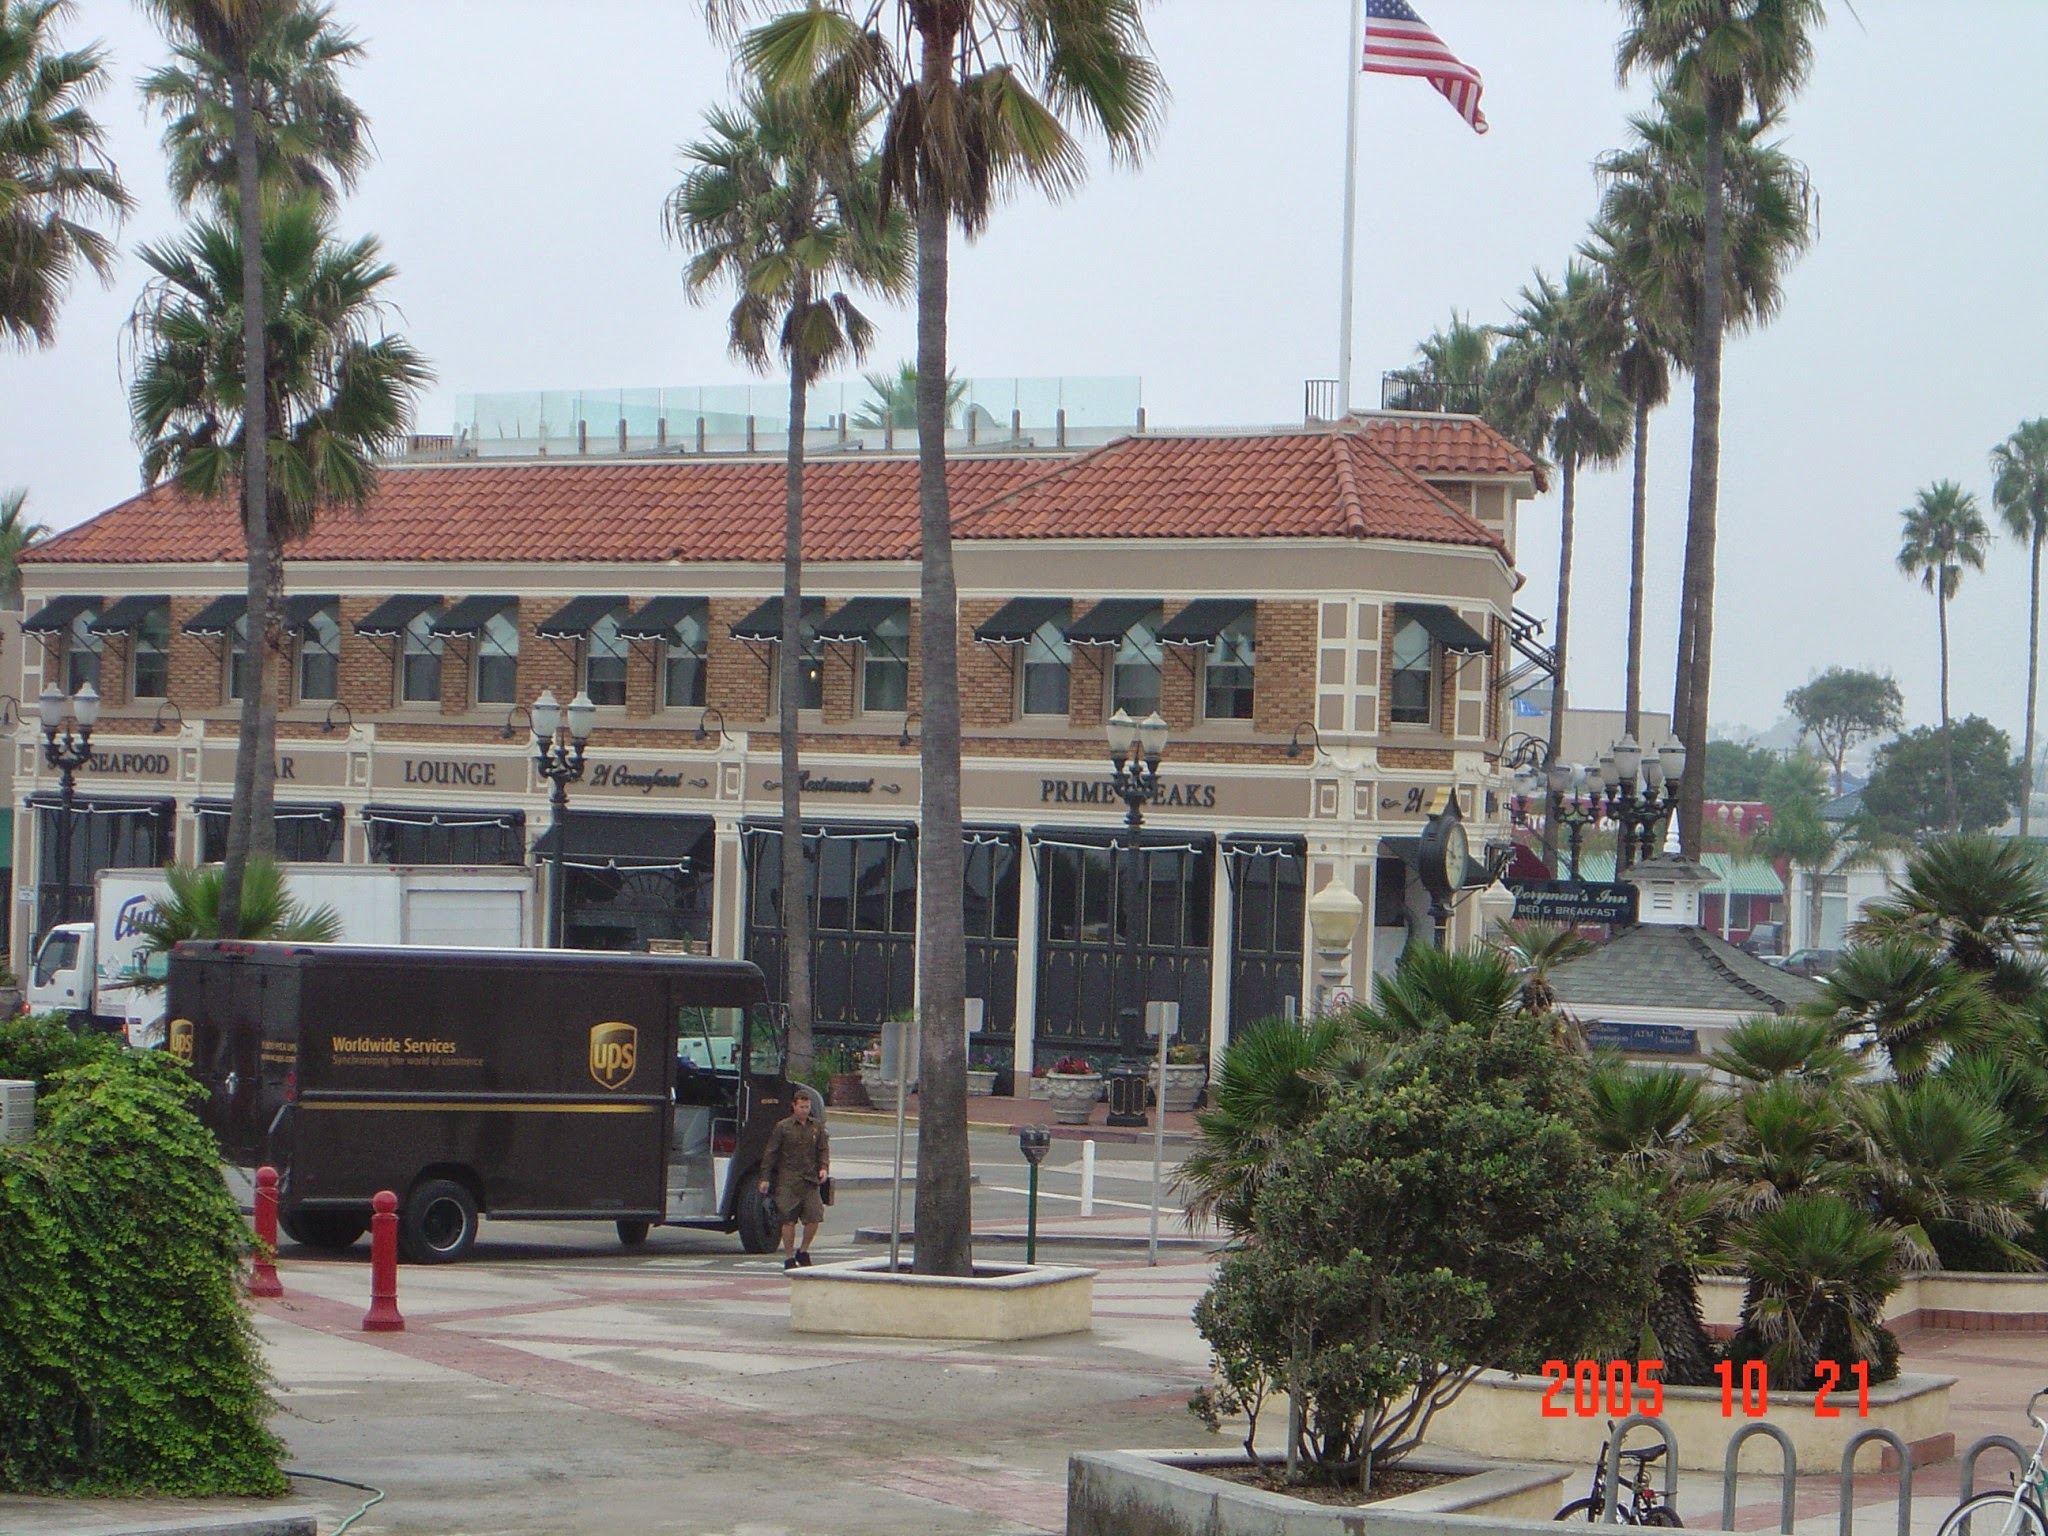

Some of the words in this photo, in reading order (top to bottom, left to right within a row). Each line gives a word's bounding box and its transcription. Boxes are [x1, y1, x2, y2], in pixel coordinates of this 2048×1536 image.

[88, 752, 170, 775] SEAFOOD
[403, 760, 496, 785] LOUNGE
[1040, 779, 1116, 804] PRIME
[1509, 884, 1589, 905] Doryman's
[1596, 889, 1628, 904] Inn
[1518, 904, 1539, 914] BED
[1543, 905, 1551, 914] &
[1555, 906, 1617, 917] BREAKFAST
[333, 1037, 400, 1053] Worldwide
[404, 1038, 457, 1054] Services
[593, 1042, 634, 1079] ups
